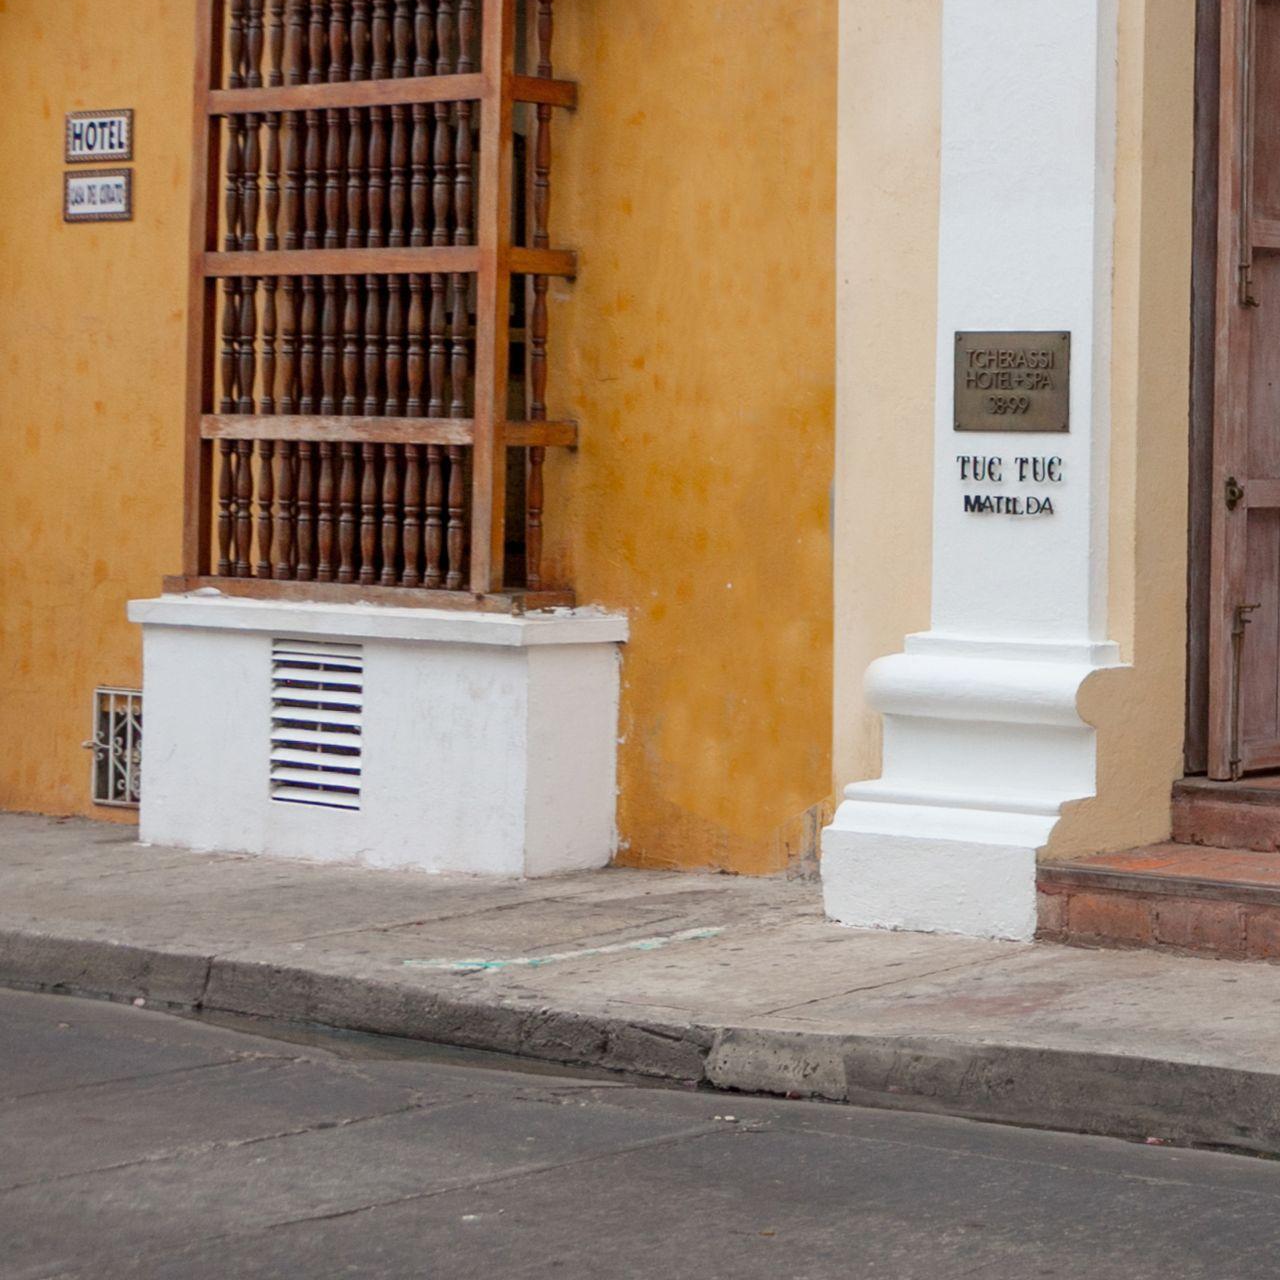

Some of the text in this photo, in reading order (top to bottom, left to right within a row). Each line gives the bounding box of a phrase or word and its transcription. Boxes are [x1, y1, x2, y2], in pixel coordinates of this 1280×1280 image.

[72, 120, 124, 151] HOTEL
[965, 348, 1055, 370] TCHERASSI
[963, 494, 1055, 516] MATILDA
